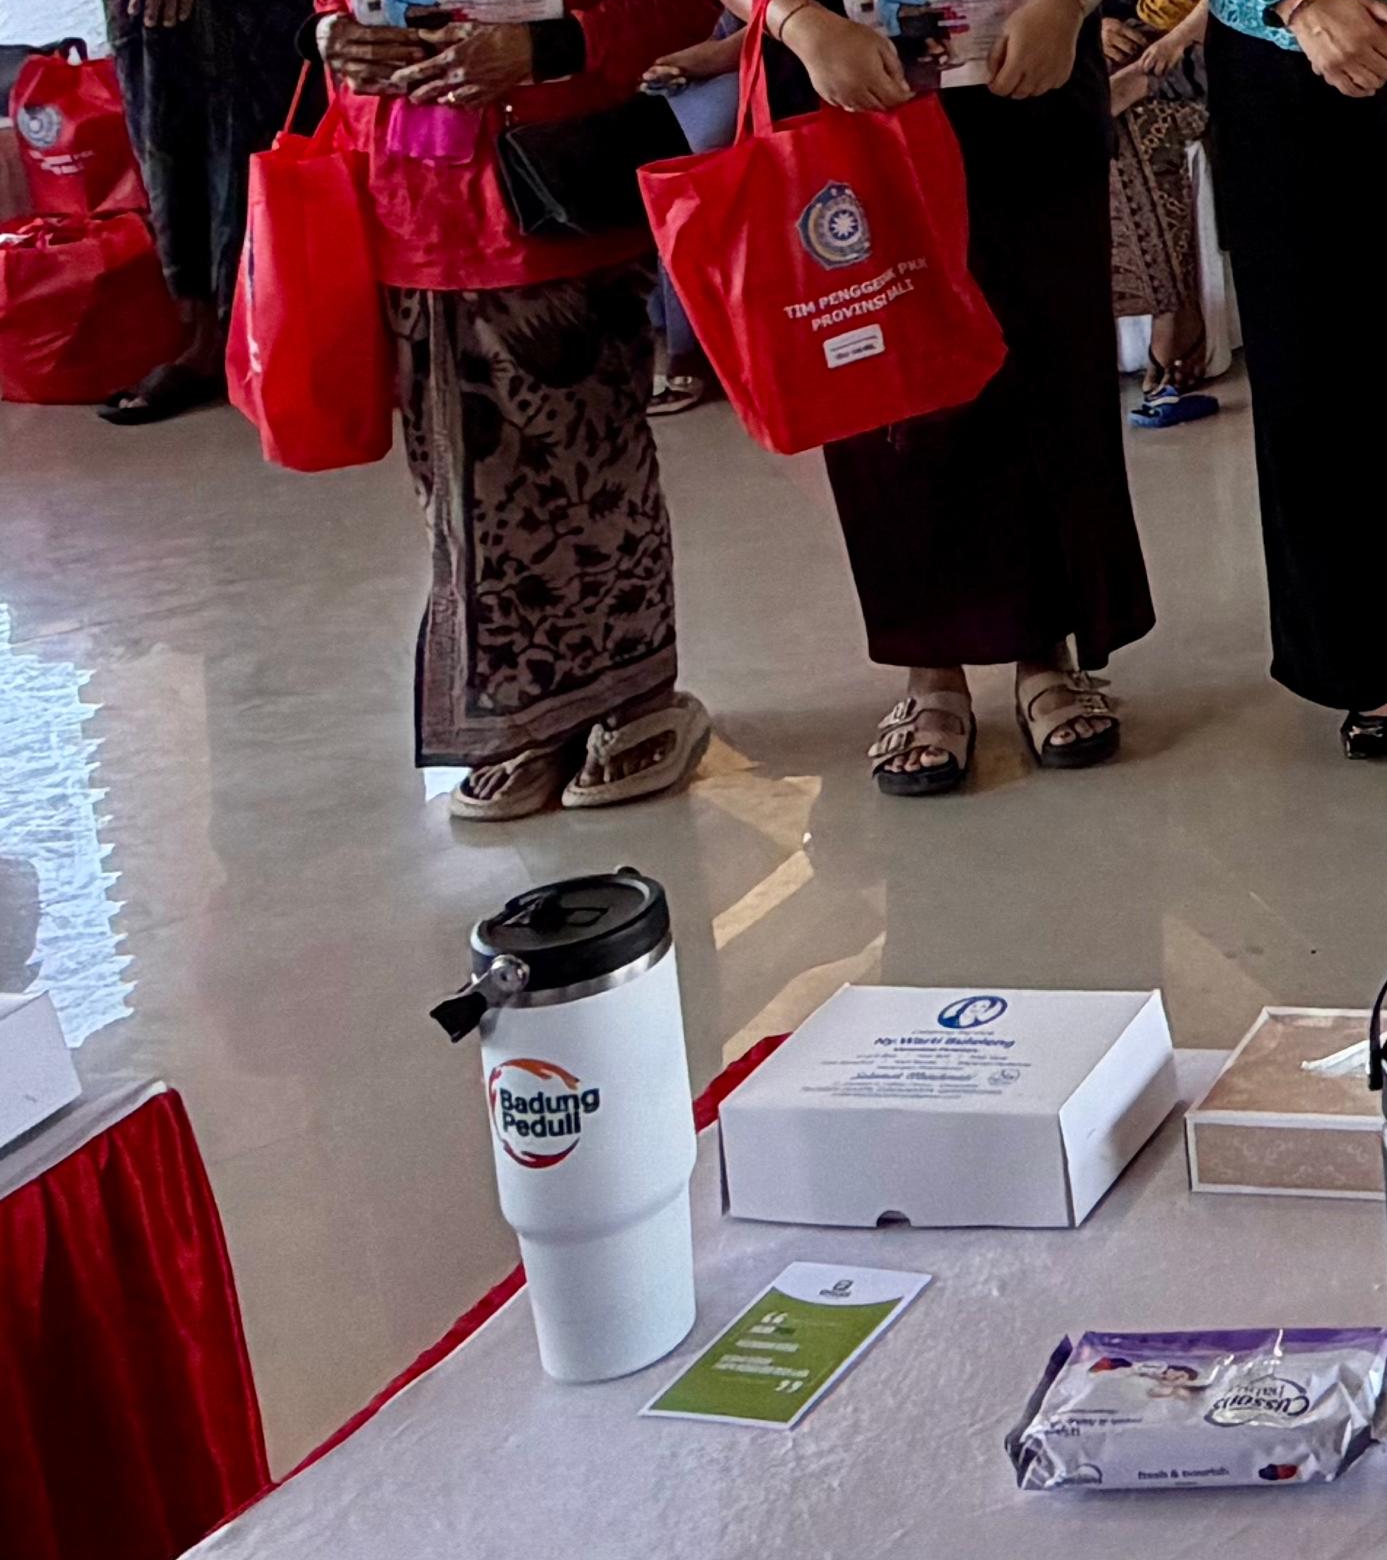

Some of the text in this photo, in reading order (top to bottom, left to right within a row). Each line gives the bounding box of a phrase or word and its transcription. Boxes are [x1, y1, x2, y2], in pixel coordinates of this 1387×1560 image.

[784, 301, 816, 319] TIM
[811, 294, 888, 332] PROVINSI
[500, 1088, 600, 1114] Badung
[503, 1111, 581, 1138] Peduli
[1212, 1393, 1310, 1417] Cussons
